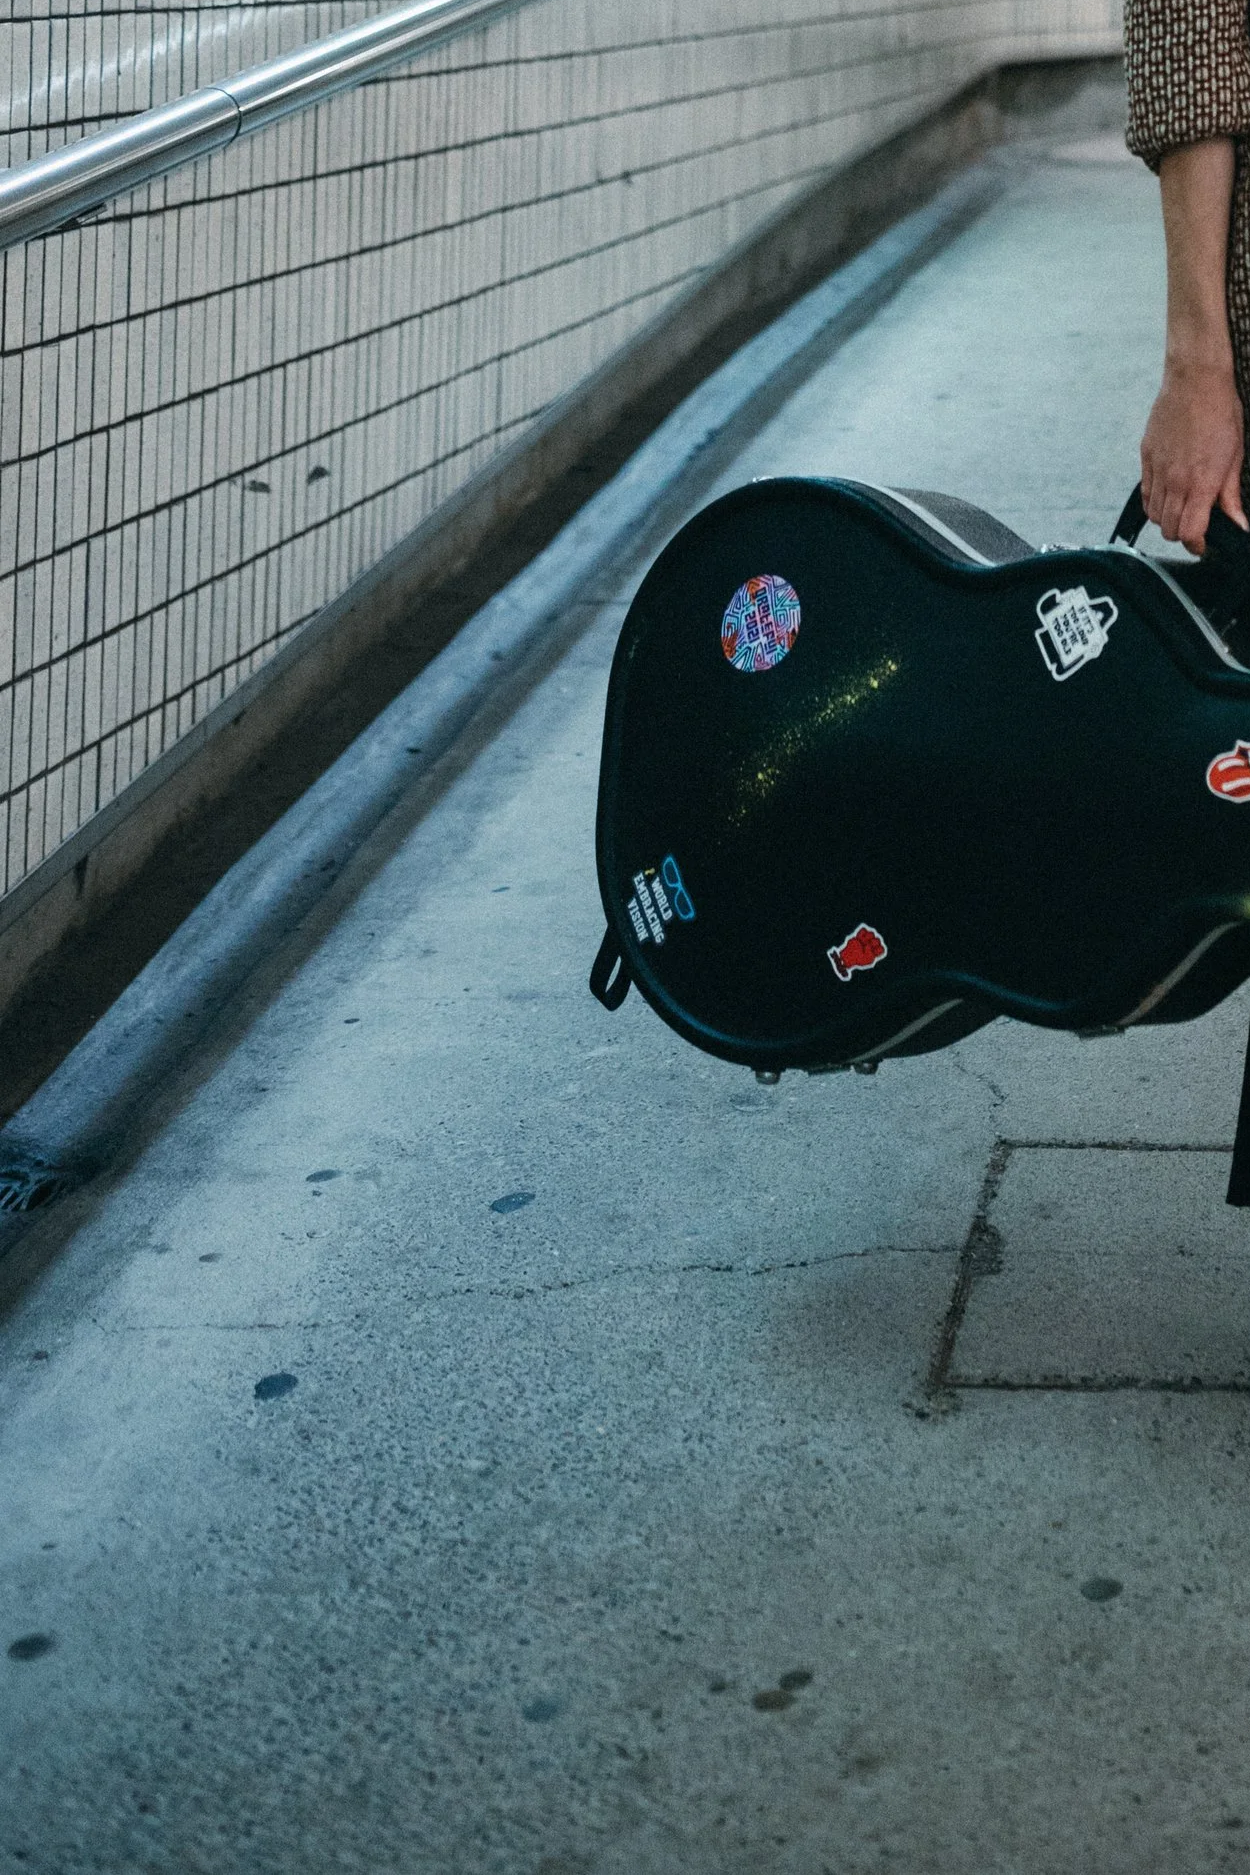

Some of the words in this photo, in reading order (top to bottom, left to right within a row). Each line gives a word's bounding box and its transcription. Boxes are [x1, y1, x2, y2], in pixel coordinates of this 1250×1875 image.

[744, 610, 761, 644] 2021
[627, 897, 649, 942] VISION
[633, 872, 665, 943] EMBRACING
[651, 876, 673, 921] WORLD
